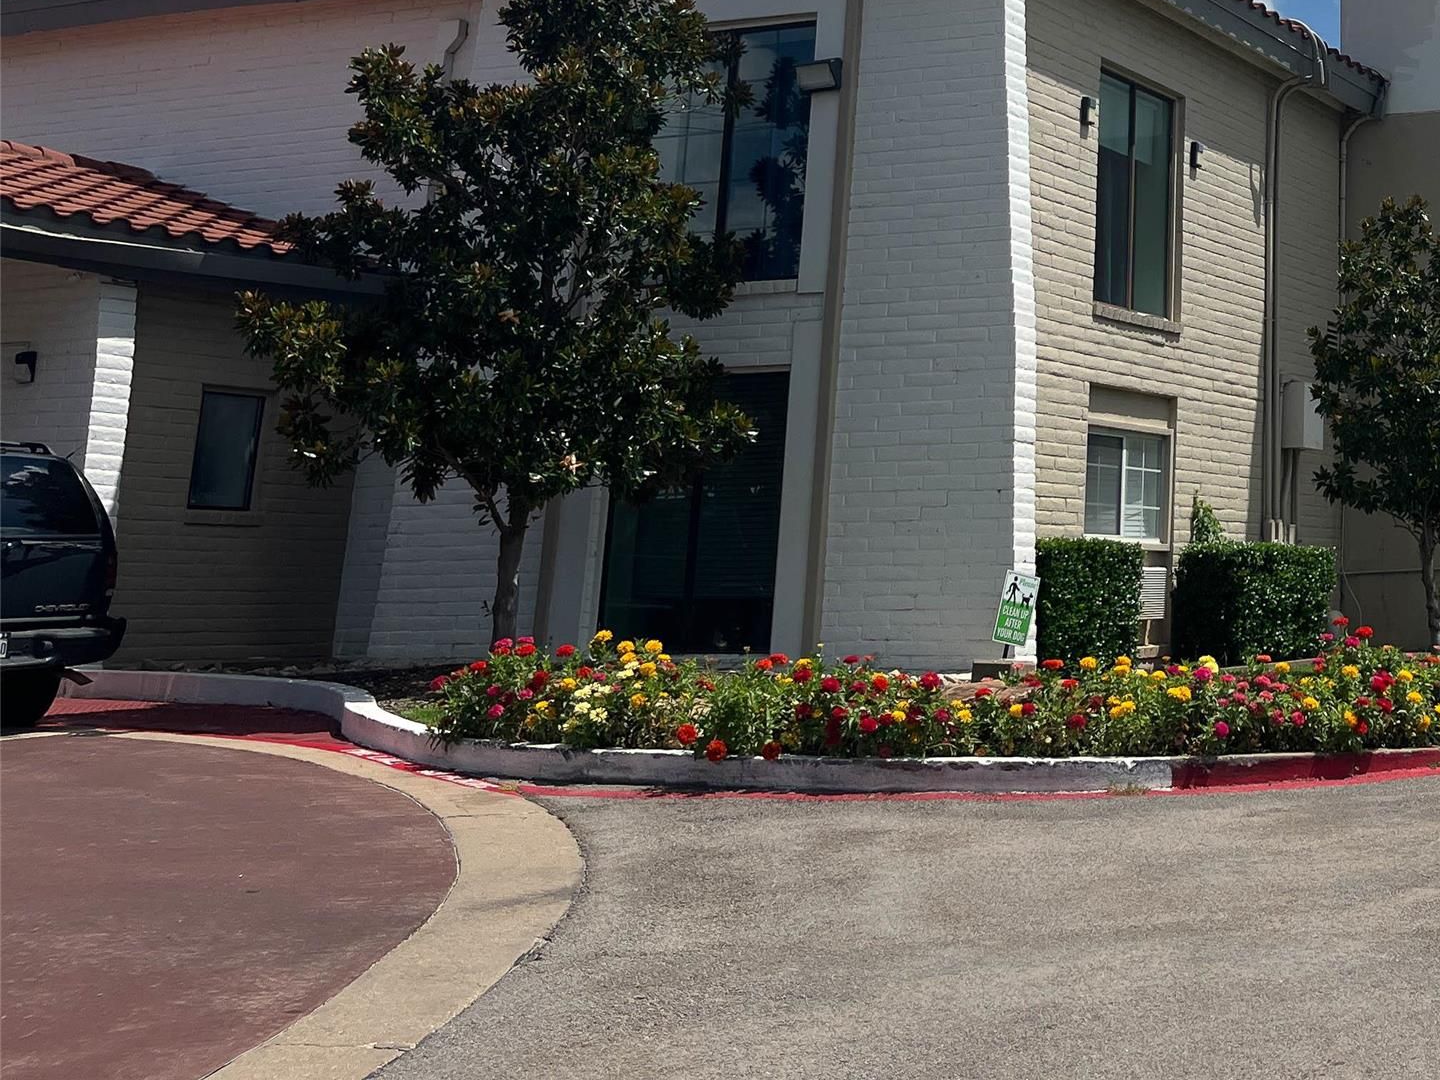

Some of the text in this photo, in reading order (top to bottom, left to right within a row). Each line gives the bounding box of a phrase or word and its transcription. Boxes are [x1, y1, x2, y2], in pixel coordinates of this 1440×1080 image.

[1003, 605, 1029, 620] CLEAN UP
[1004, 618, 1022, 629] AFTER
[996, 627, 1026, 641] YOUR DOG
